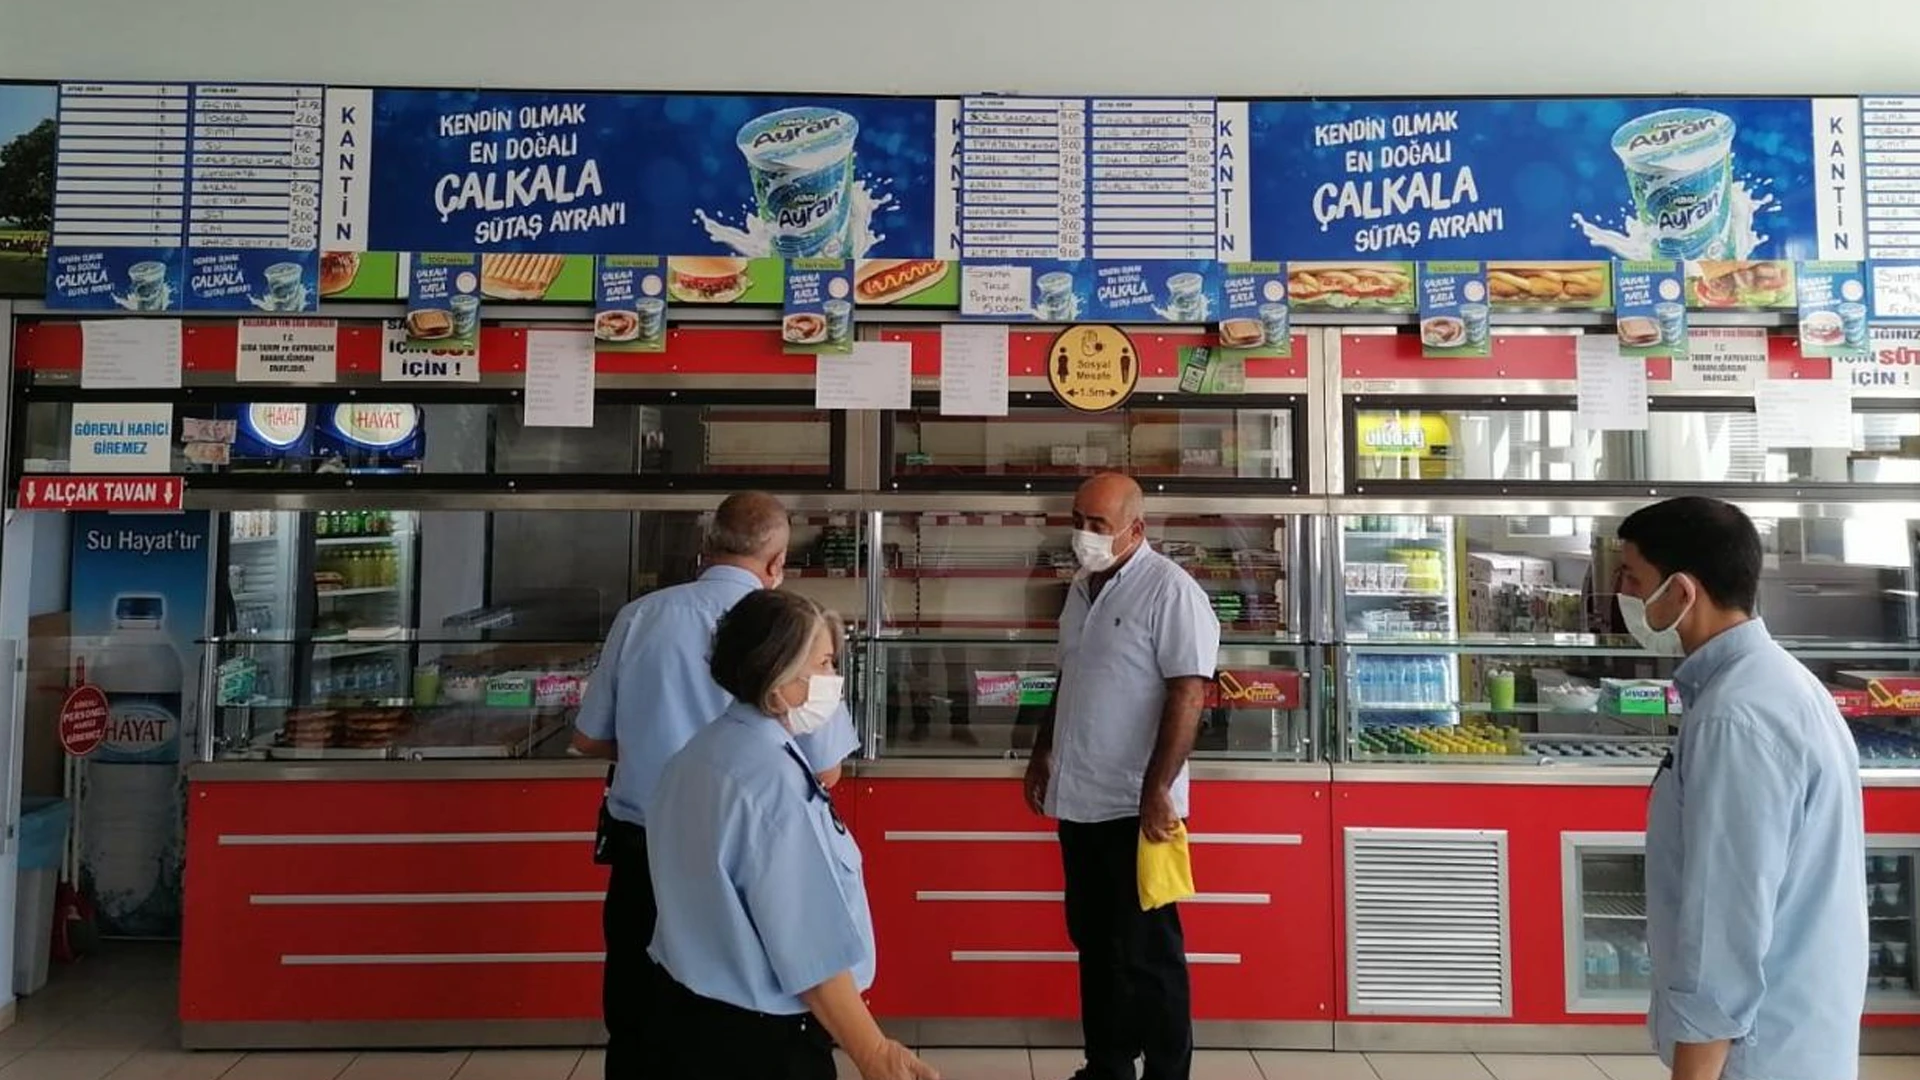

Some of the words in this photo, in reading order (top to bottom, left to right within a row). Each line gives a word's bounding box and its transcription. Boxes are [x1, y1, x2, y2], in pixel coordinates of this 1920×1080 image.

[440, 109, 512, 137] KENDİN
[519, 103, 586, 129] OLMAK
[753, 115, 840, 149] Ayran
[1315, 116, 1385, 147] KENDİN
[1392, 110, 1459, 137] OLMAK
[1628, 117, 1715, 150] Ayran
[470, 141, 497, 164] EN
[505, 131, 577, 160] DOĞALI
[1345, 150, 1372, 173] EN
[1381, 139, 1451, 169] DOĞALI
[336, 106, 356, 241] KANTİN
[1219, 119, 1235, 251] KANTİN
[1829, 116, 1849, 250] KANTİN
[434, 159, 603, 222] ÇALKALA
[1312, 165, 1479, 232] ÇALKALA
[475, 212, 543, 244] SÜTAŞ
[549, 202, 626, 233] AYRAN'I
[778, 191, 839, 229] Ayran
[1658, 189, 1719, 231] Ayran
[1354, 221, 1421, 252] SÜTAŞ
[1428, 207, 1504, 240] AYRAN'I
[55, 269, 109, 290] ÇALKALA
[191, 271, 245, 291] ÇALKALA
[402, 359, 447, 377] İÇİN
[1076, 371, 1112, 380] Mesafe
[1078, 360, 1111, 371] Sosyal
[1850, 369, 1896, 387] İÇİN
[74, 419, 124, 437] GÖREVLİ
[127, 420, 169, 436] HARİCİ
[266, 406, 300, 426] HAYAT
[357, 410, 402, 429] HAYAT
[93, 440, 148, 455] GİREMEZ
[44, 483, 99, 506] ALÇAK
[104, 482, 157, 501] TAVAN
[86, 530, 110, 550] Su
[118, 530, 201, 554] Hayat'tır
[104, 719, 169, 742] HAYAT
